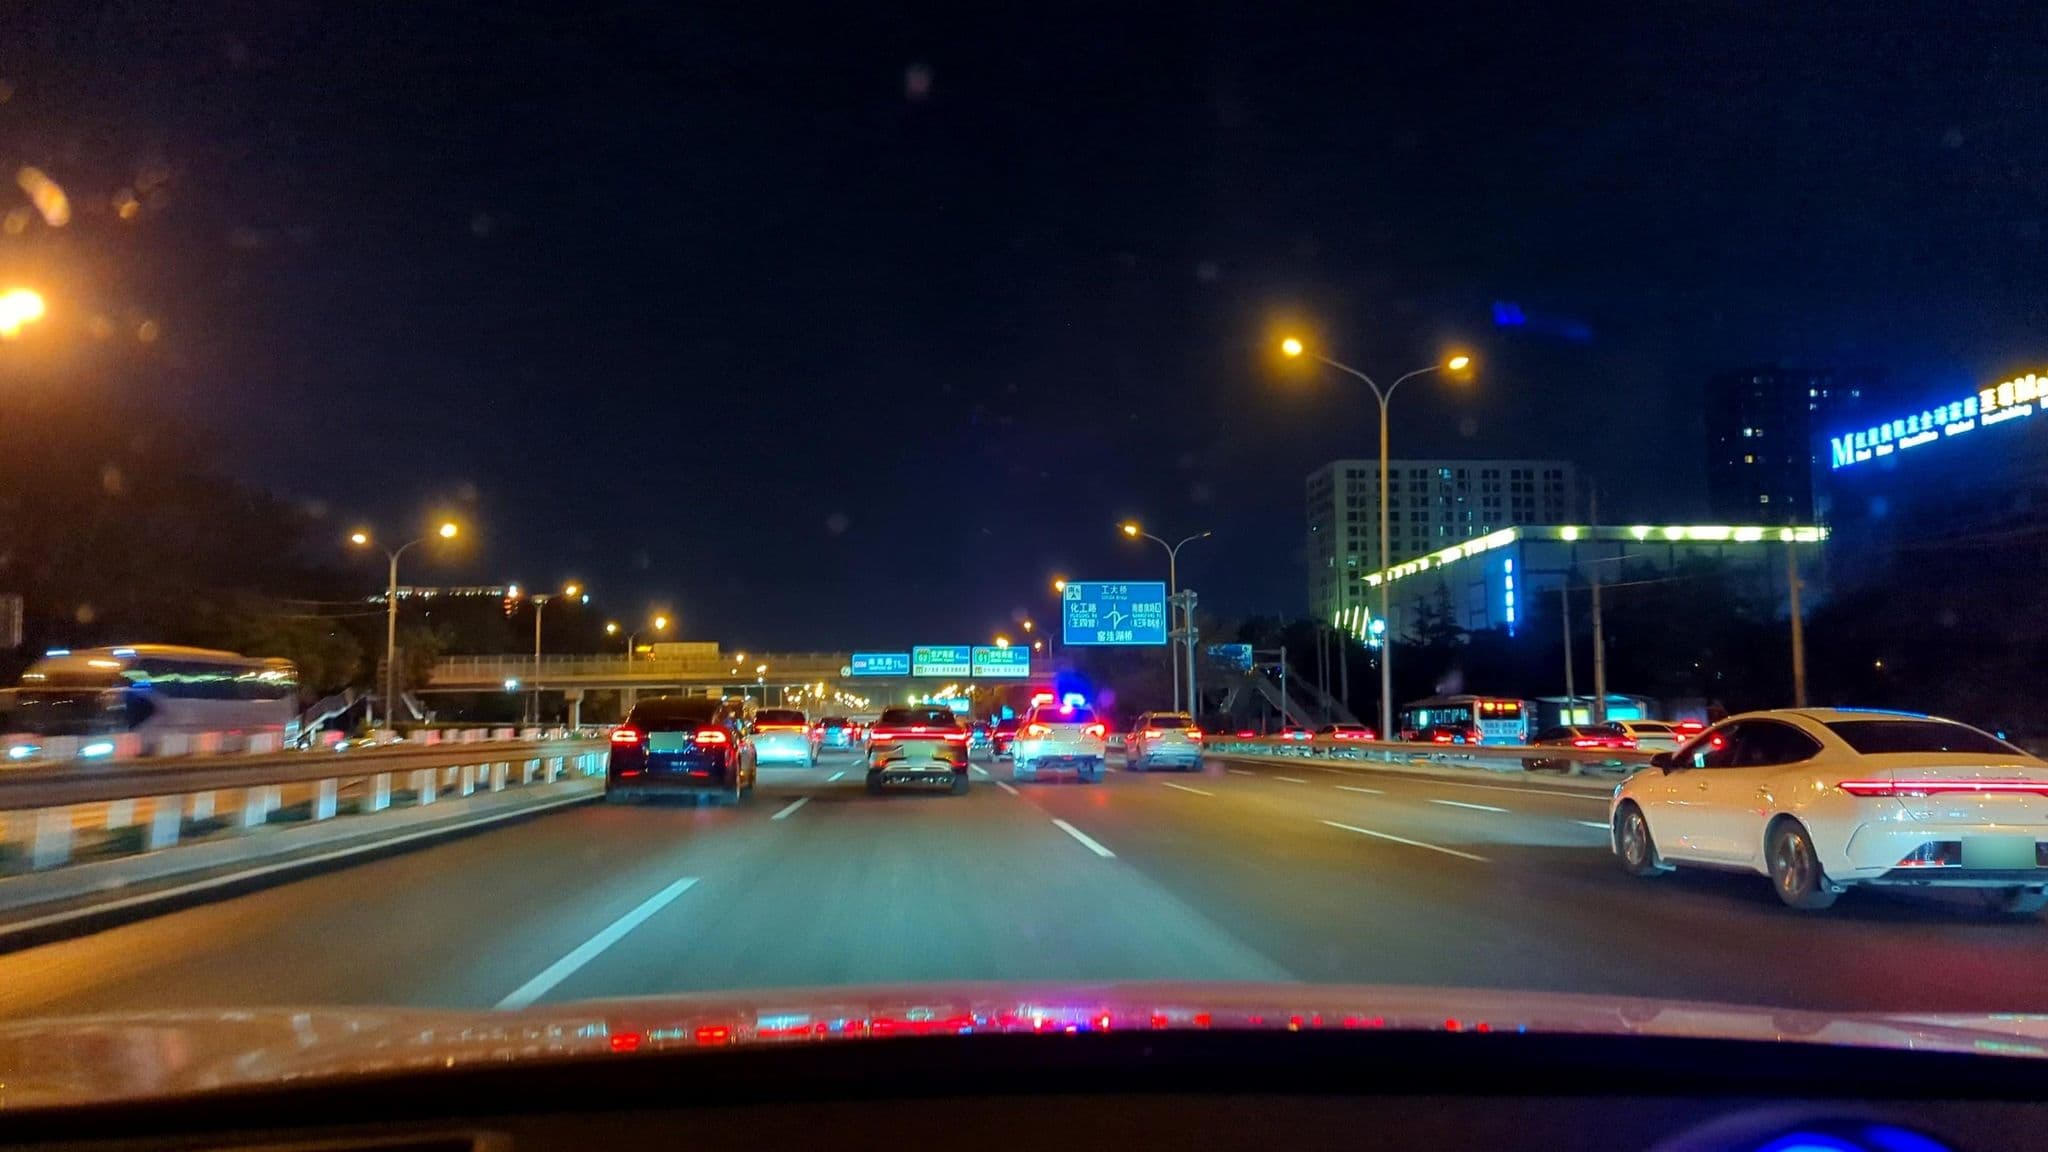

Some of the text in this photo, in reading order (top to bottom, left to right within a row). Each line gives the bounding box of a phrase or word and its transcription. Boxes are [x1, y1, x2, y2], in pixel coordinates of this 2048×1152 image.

[1831, 433, 1855, 469] M
[1101, 585, 1127, 595] 工大桥
[1070, 602, 1097, 613] 化工路
